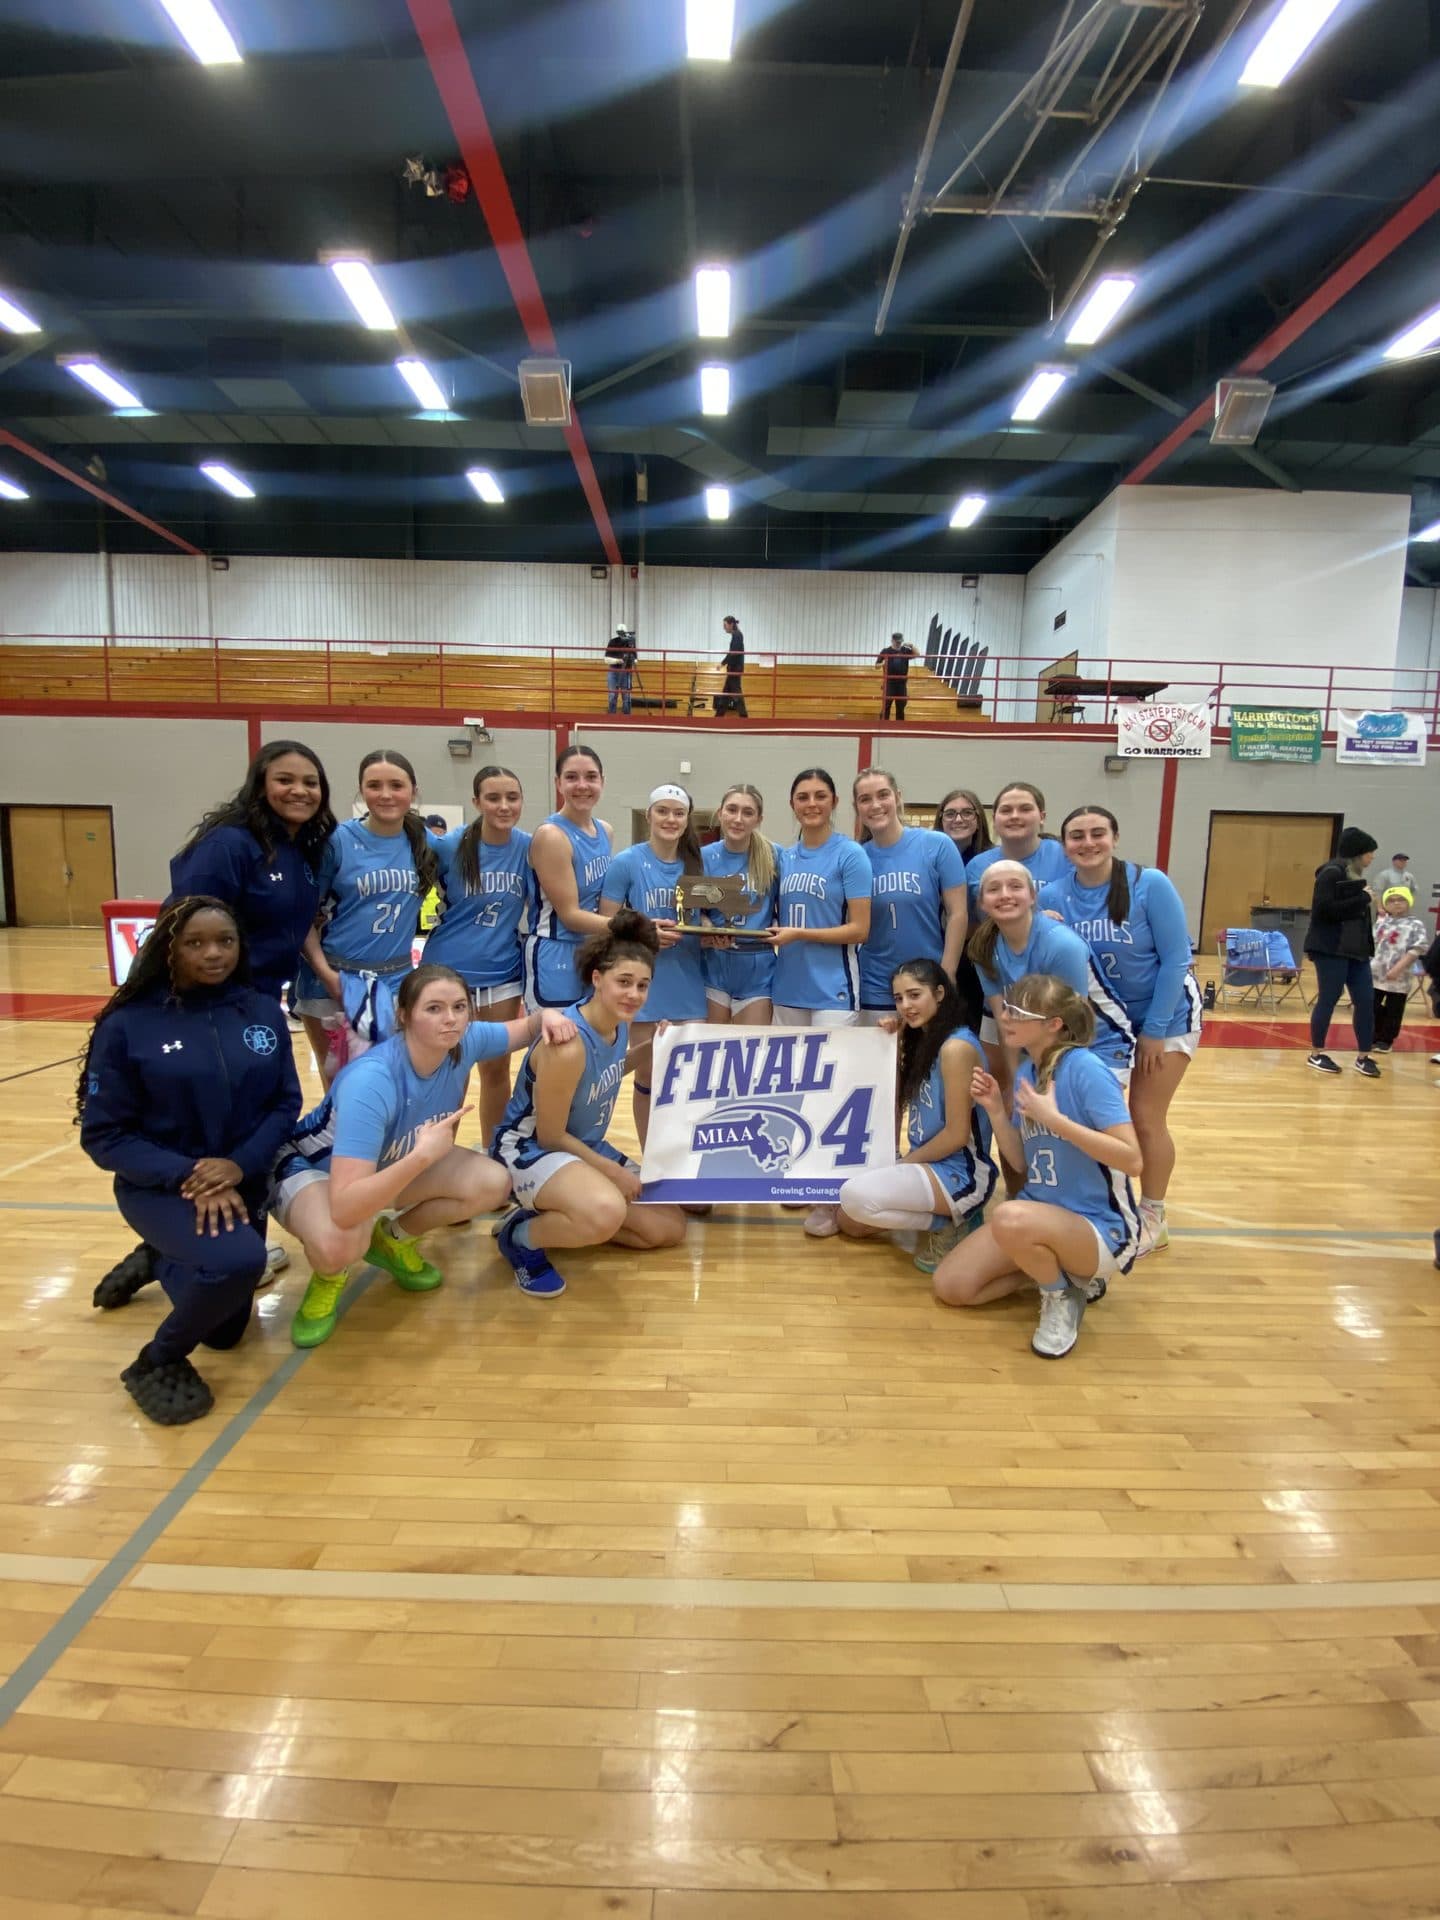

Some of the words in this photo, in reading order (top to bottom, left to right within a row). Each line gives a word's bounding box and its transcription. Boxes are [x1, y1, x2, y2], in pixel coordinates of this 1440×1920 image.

[1266, 722, 1317, 731] Restaurant
[1124, 747, 1141, 755] GO
[1144, 748, 1202, 756] WARRIORS!
[872, 871, 921, 897] IDDIES
[372, 903, 401, 934] 21
[789, 903, 806, 928] 10
[890, 903, 897, 929] 1
[1071, 918, 1133, 945] DDIES
[1100, 952, 1121, 978] 2
[655, 1033, 836, 1107] FINAL
[697, 1125, 754, 1145] MIAA
[819, 1087, 875, 1167] 4
[1028, 1149, 1058, 1187] 33
[770, 1186, 804, 1196] Growing
